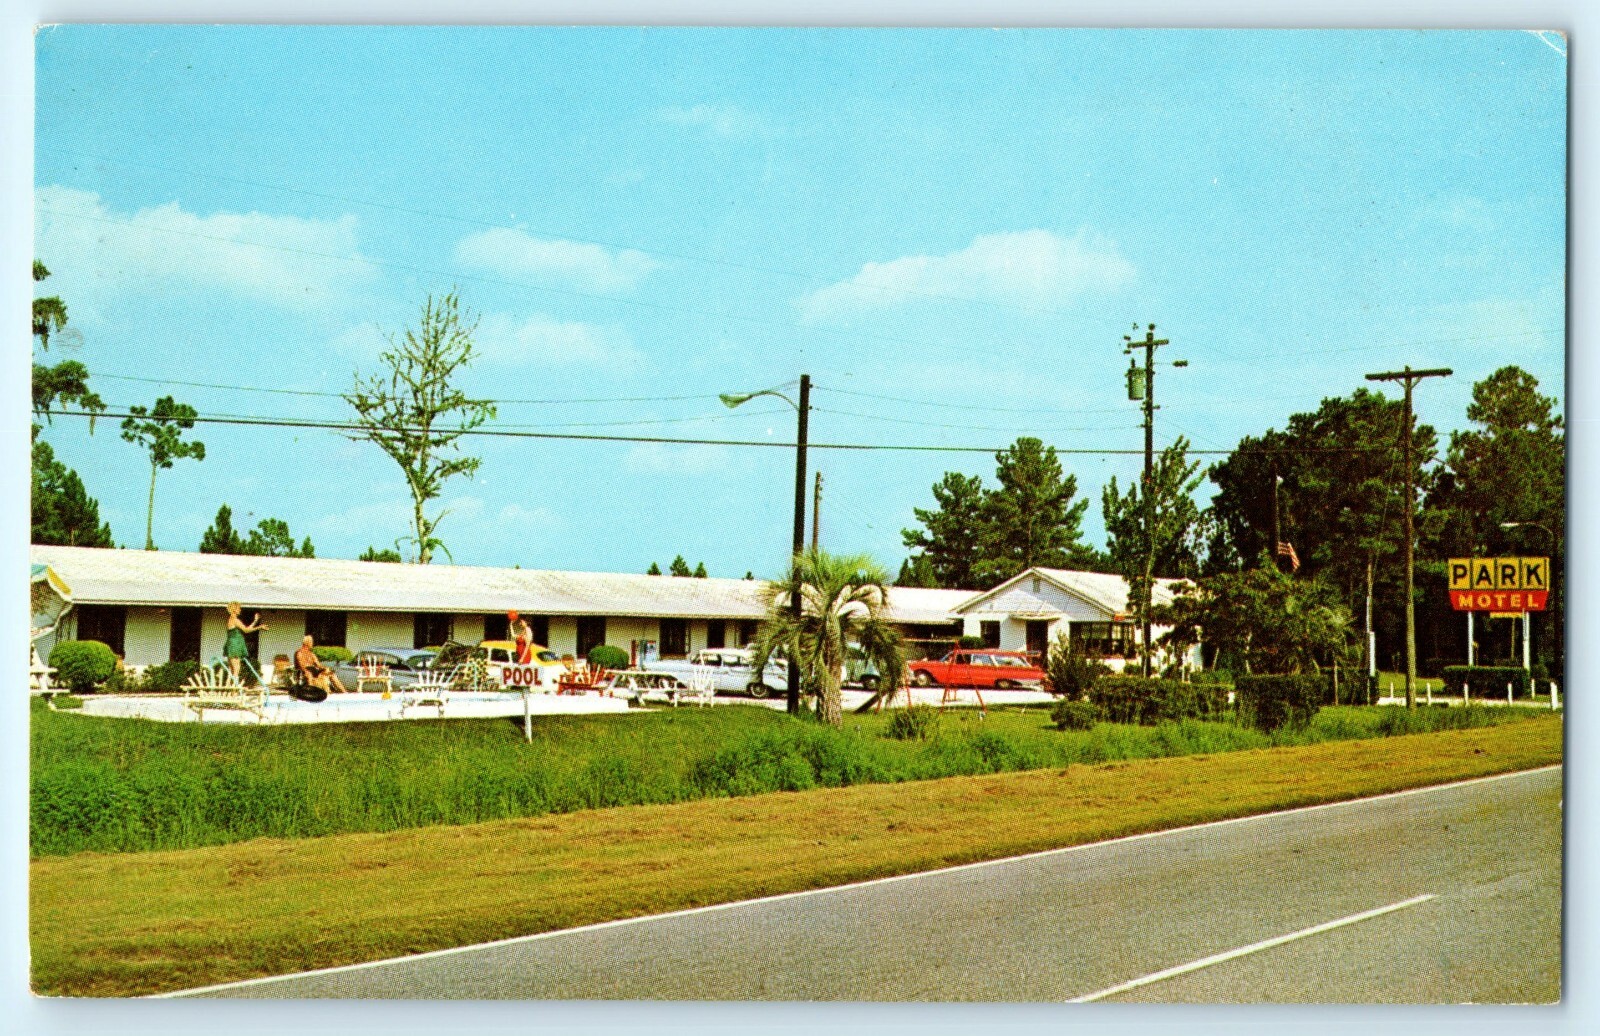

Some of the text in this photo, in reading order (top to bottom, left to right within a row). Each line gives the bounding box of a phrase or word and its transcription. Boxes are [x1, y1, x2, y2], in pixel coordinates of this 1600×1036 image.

[1452, 564, 1543, 586] PARK
[1458, 593, 1539, 608] MOTEL
[502, 667, 542, 686] POOL
